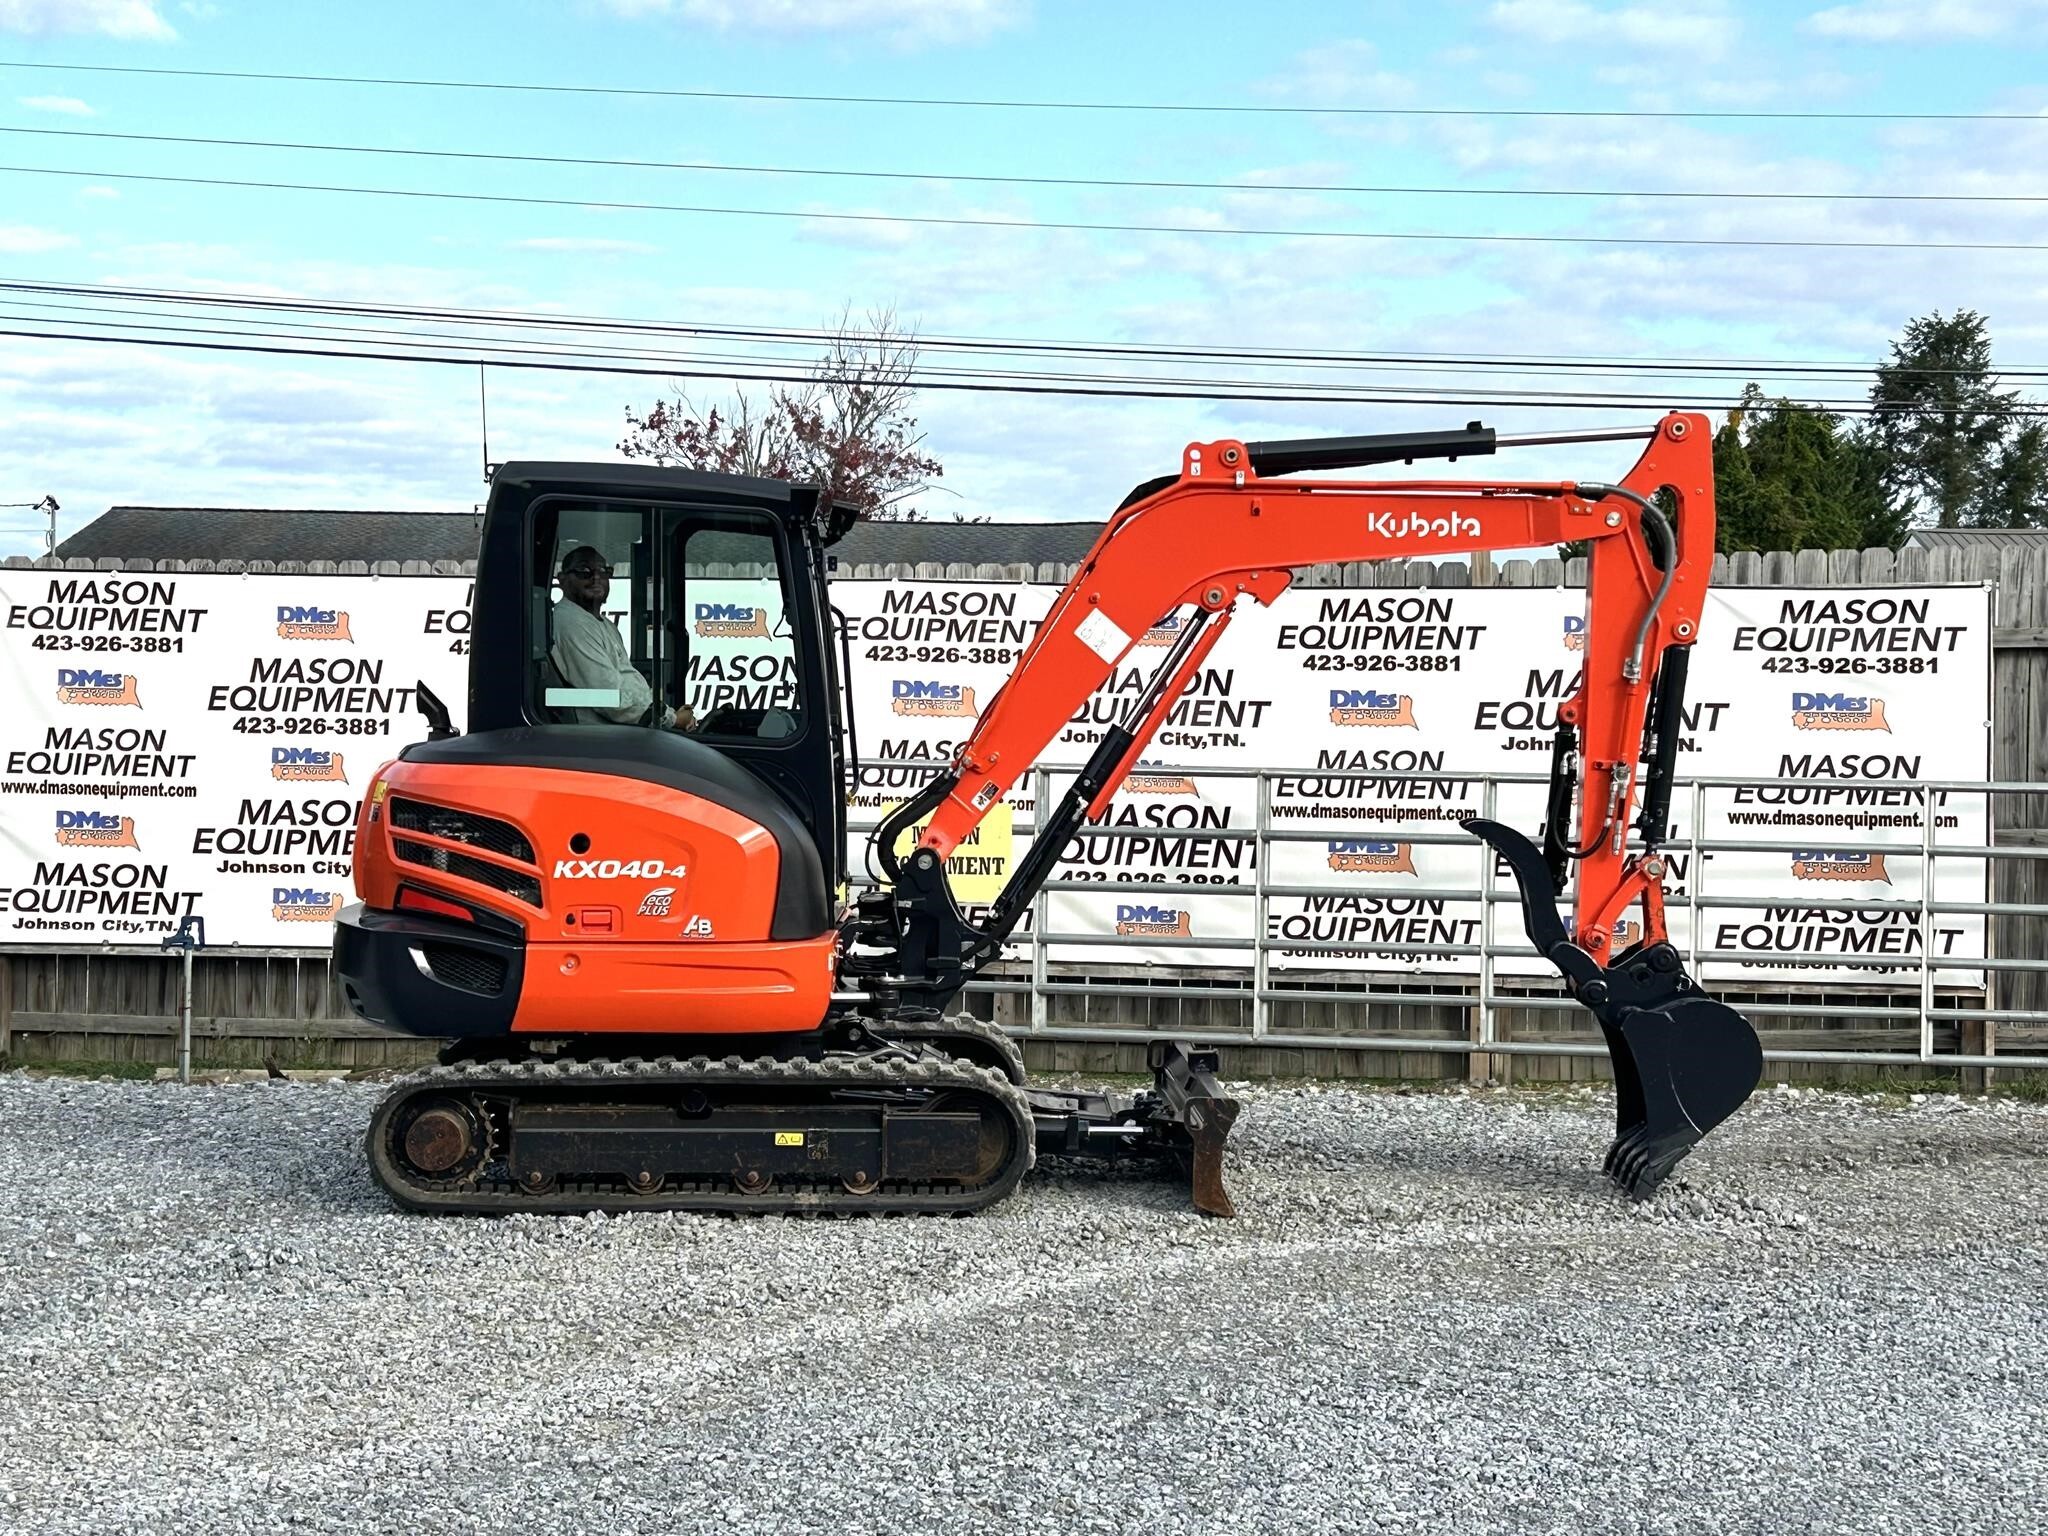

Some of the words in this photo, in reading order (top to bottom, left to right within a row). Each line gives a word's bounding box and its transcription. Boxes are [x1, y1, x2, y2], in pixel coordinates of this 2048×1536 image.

[1368, 511, 1481, 538] Kubota
[47, 580, 176, 605] MASON
[882, 590, 1017, 616] MASON
[6, 605, 208, 632] EQUIPMENT
[1318, 598, 1453, 622] MASON
[1779, 599, 1930, 624] MASON
[31, 635, 183, 653] 423-926-3881
[1277, 625, 1486, 650] EQUIPMENT
[1733, 626, 1967, 653] EQUIPMENT
[250, 658, 382, 684] MASON
[1302, 655, 1461, 672] 423-926-3881
[1761, 658, 1939, 674] 423-926-3881
[208, 686, 417, 713] EQUIPMENT
[233, 718, 390, 735] 423-926-3881
[45, 727, 166, 752] MASON
[1159, 731, 1246, 749] City,TN.
[6, 752, 196, 778] EQUIPMENT
[1317, 750, 1444, 771] MASON
[1778, 754, 1921, 779] MASON
[1, 781, 197, 799] www.dmasonequipment.com
[1271, 803, 1477, 823] www.dmasonequipment.com
[1728, 809, 1959, 830] www.dmasonequipment.om
[33, 862, 168, 888] MASON
[217, 860, 306, 874] Johnson
[553, 860, 687, 879] KX040-4
[1303, 896, 1445, 916] MASON
[12, 917, 95, 930] Johnson
[101, 919, 178, 933] City,TN.
[1268, 915, 1483, 944] EQUIPMENT
